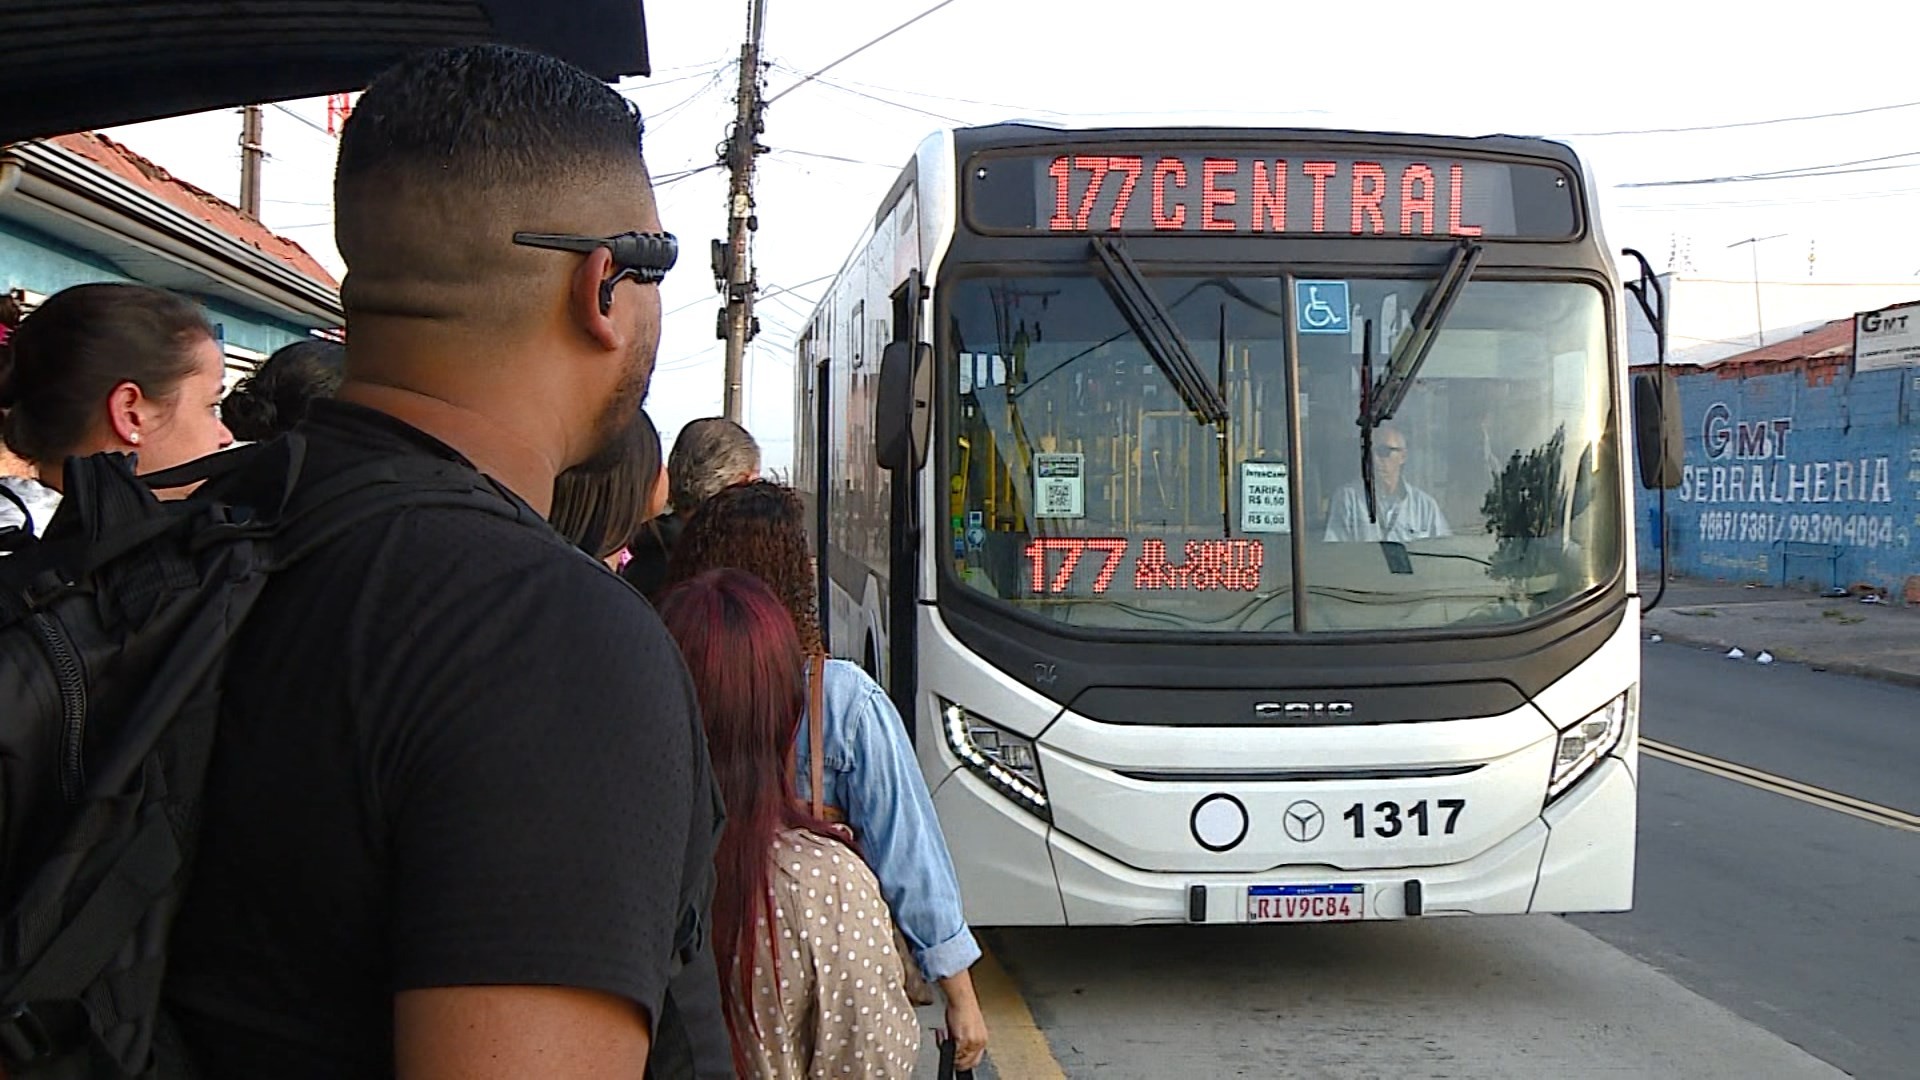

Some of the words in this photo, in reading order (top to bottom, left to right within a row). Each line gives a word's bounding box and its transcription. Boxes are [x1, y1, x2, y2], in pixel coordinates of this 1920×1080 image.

[1048, 155, 1143, 231] 177
[1151, 157, 1482, 236] CENTRAL
[1703, 402, 1792, 461] GMT
[1248, 485, 1285, 494] TARIFA
[1679, 457, 1892, 503] SERRALHERIA
[1248, 495, 1262, 505] R$
[1248, 515, 1262, 525] R$
[1025, 538, 1128, 592] 177
[1185, 539, 1264, 569] SANTO
[1135, 562, 1262, 591] ANTONIO
[1343, 800, 1465, 838] 1317
[1258, 897, 1351, 918] RIV9C84
